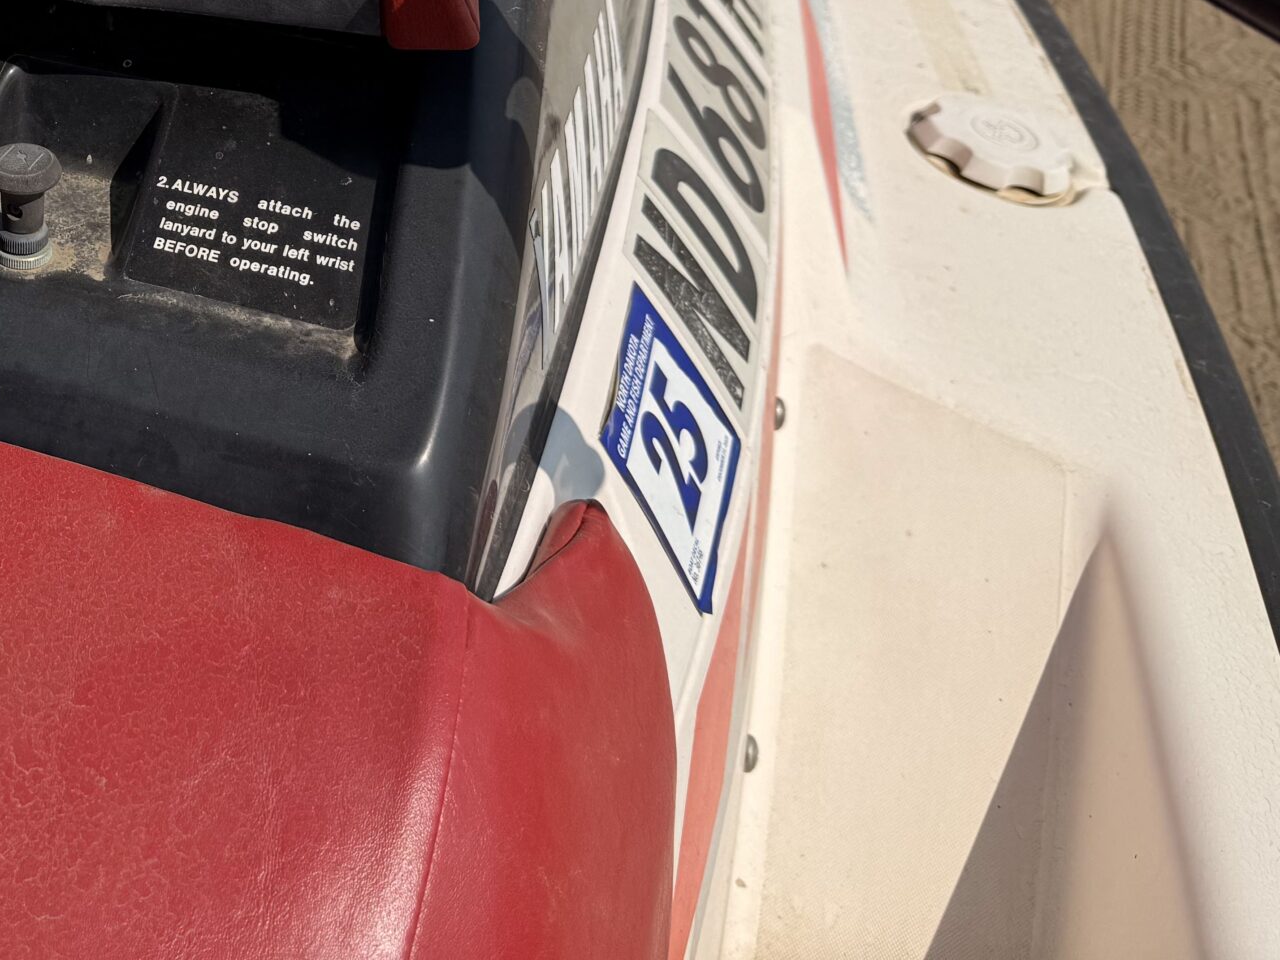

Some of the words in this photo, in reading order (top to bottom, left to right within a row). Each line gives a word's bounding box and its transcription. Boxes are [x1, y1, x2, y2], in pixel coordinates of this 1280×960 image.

[165, 200, 220, 220] engine
[242, 216, 279, 235] stop
[303, 229, 358, 252] switch
[257, 198, 313, 220] attach
[333, 213, 361, 231] the
[153, 236, 221, 263] BEFORE
[229, 257, 314, 286] operating.
[159, 217, 216, 240] lanyard
[221, 230, 237, 245] to
[241, 237, 278, 255] your
[282, 244, 310, 262] left
[315, 254, 355, 273] wrist
[640, 360, 709, 537] 25
